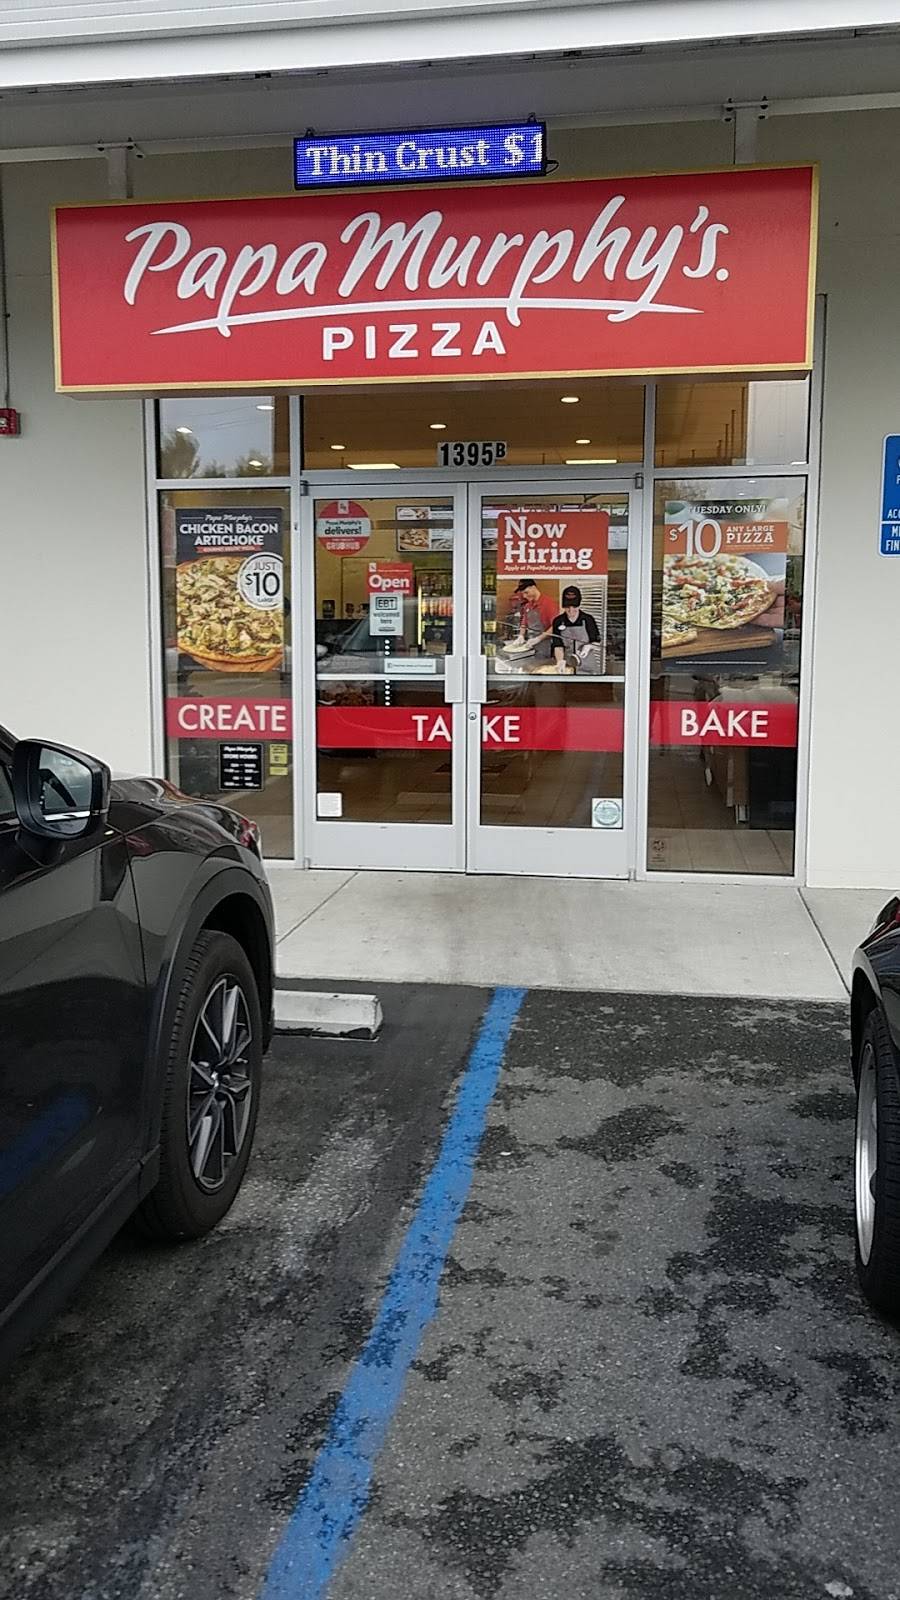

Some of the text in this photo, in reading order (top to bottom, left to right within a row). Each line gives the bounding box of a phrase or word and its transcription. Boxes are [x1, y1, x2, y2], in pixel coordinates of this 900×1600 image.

[305, 145, 388, 176] Thin
[396, 139, 490, 170] Crust
[124, 221, 328, 337] Papa
[322, 320, 507, 361] PIZZA
[688, 503, 769, 515] TUESDAY ONLY!
[179, 523, 279, 534] CHICKEN BACON
[324, 526, 362, 536] delivers!
[503, 515, 568, 539] Now
[669, 518, 722, 559] $10
[726, 532, 775, 544] PIZZA
[194, 535, 265, 546] ARTICHOKE
[254, 561, 277, 571] JUST
[503, 540, 594, 570] Hiring
[245, 571, 281, 597] $10
[368, 574, 410, 592] Open
[378, 599, 394, 608] EBT
[177, 704, 288, 732] CREATE
[680, 709, 769, 739] BAKE
